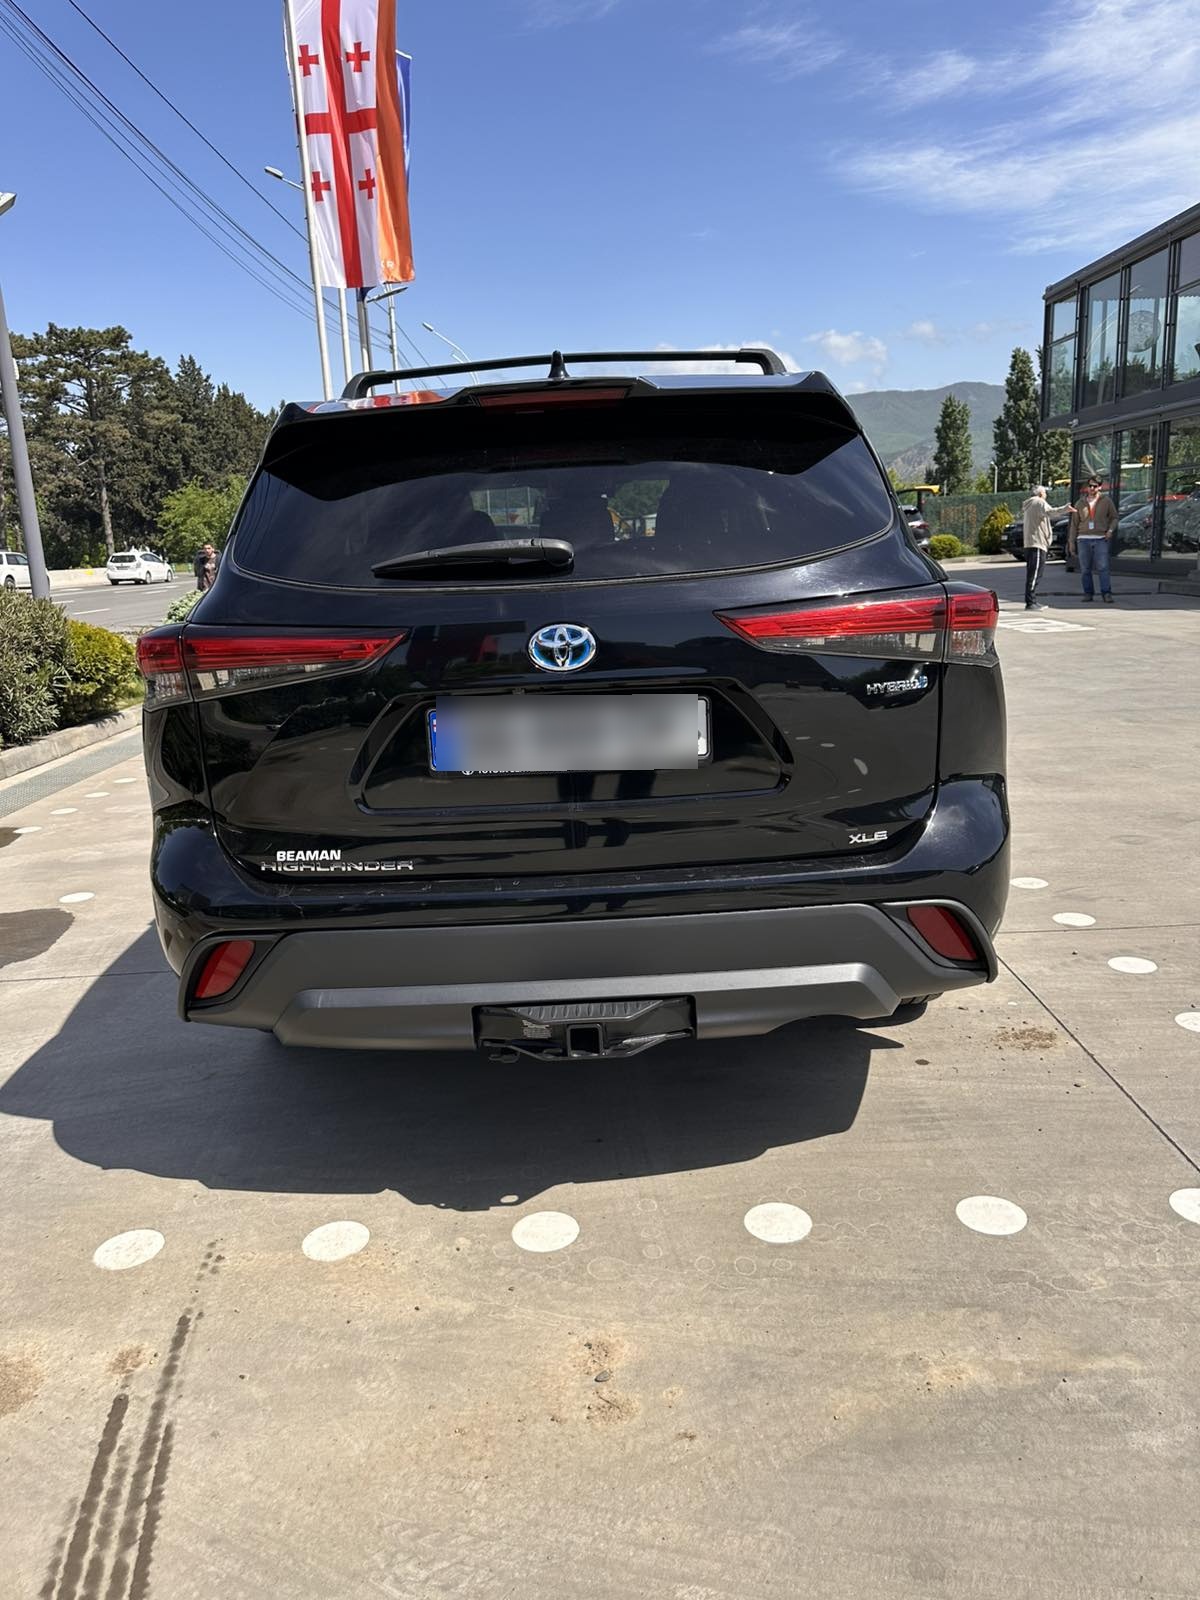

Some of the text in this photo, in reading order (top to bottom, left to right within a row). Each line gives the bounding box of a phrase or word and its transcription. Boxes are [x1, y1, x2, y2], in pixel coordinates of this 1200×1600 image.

[866, 678, 919, 695] HYBRID
[849, 830, 888, 844] XLE
[276, 849, 341, 861] BEAMAN
[261, 860, 414, 872] HIGHLANDER
